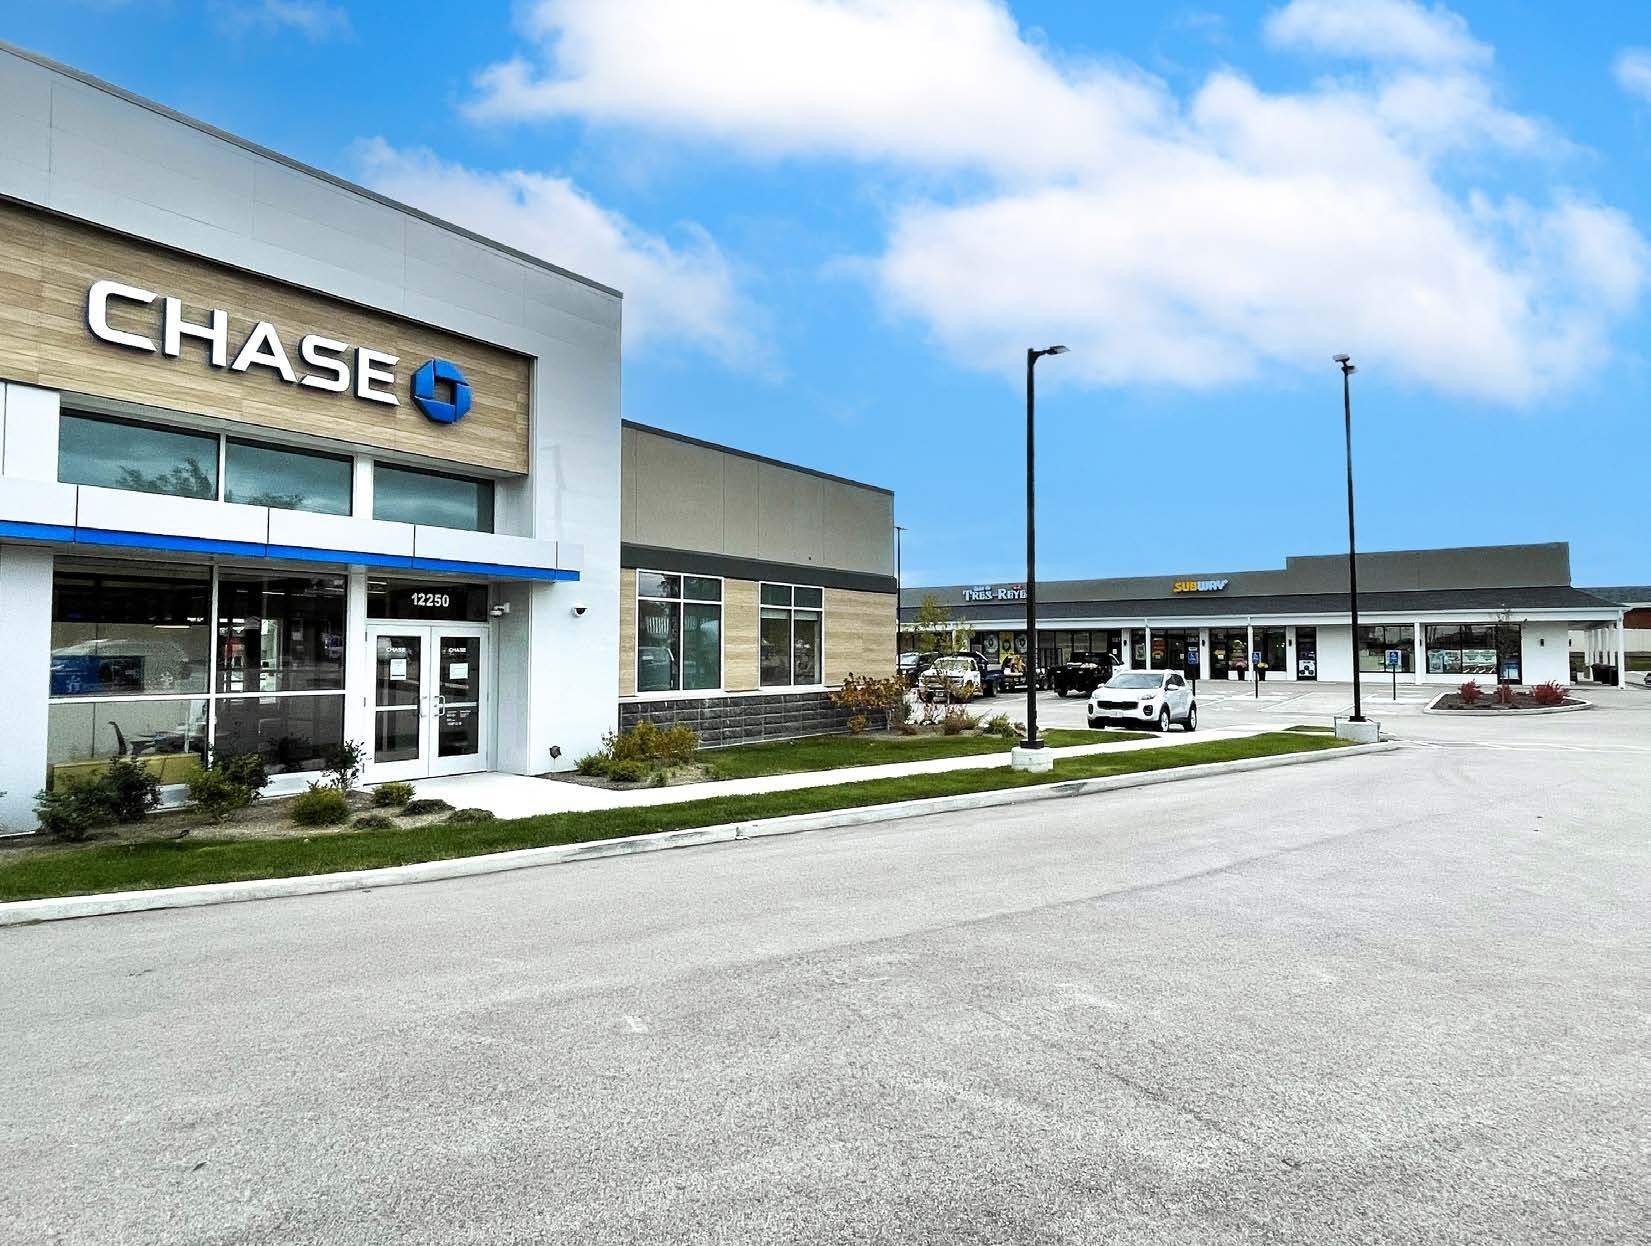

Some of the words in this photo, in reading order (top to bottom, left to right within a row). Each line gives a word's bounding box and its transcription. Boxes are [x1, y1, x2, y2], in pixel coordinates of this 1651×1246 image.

[87, 280, 400, 406] CHASE
[1173, 579, 1228, 592] SUBWAY
[411, 592, 450, 607] 12250
